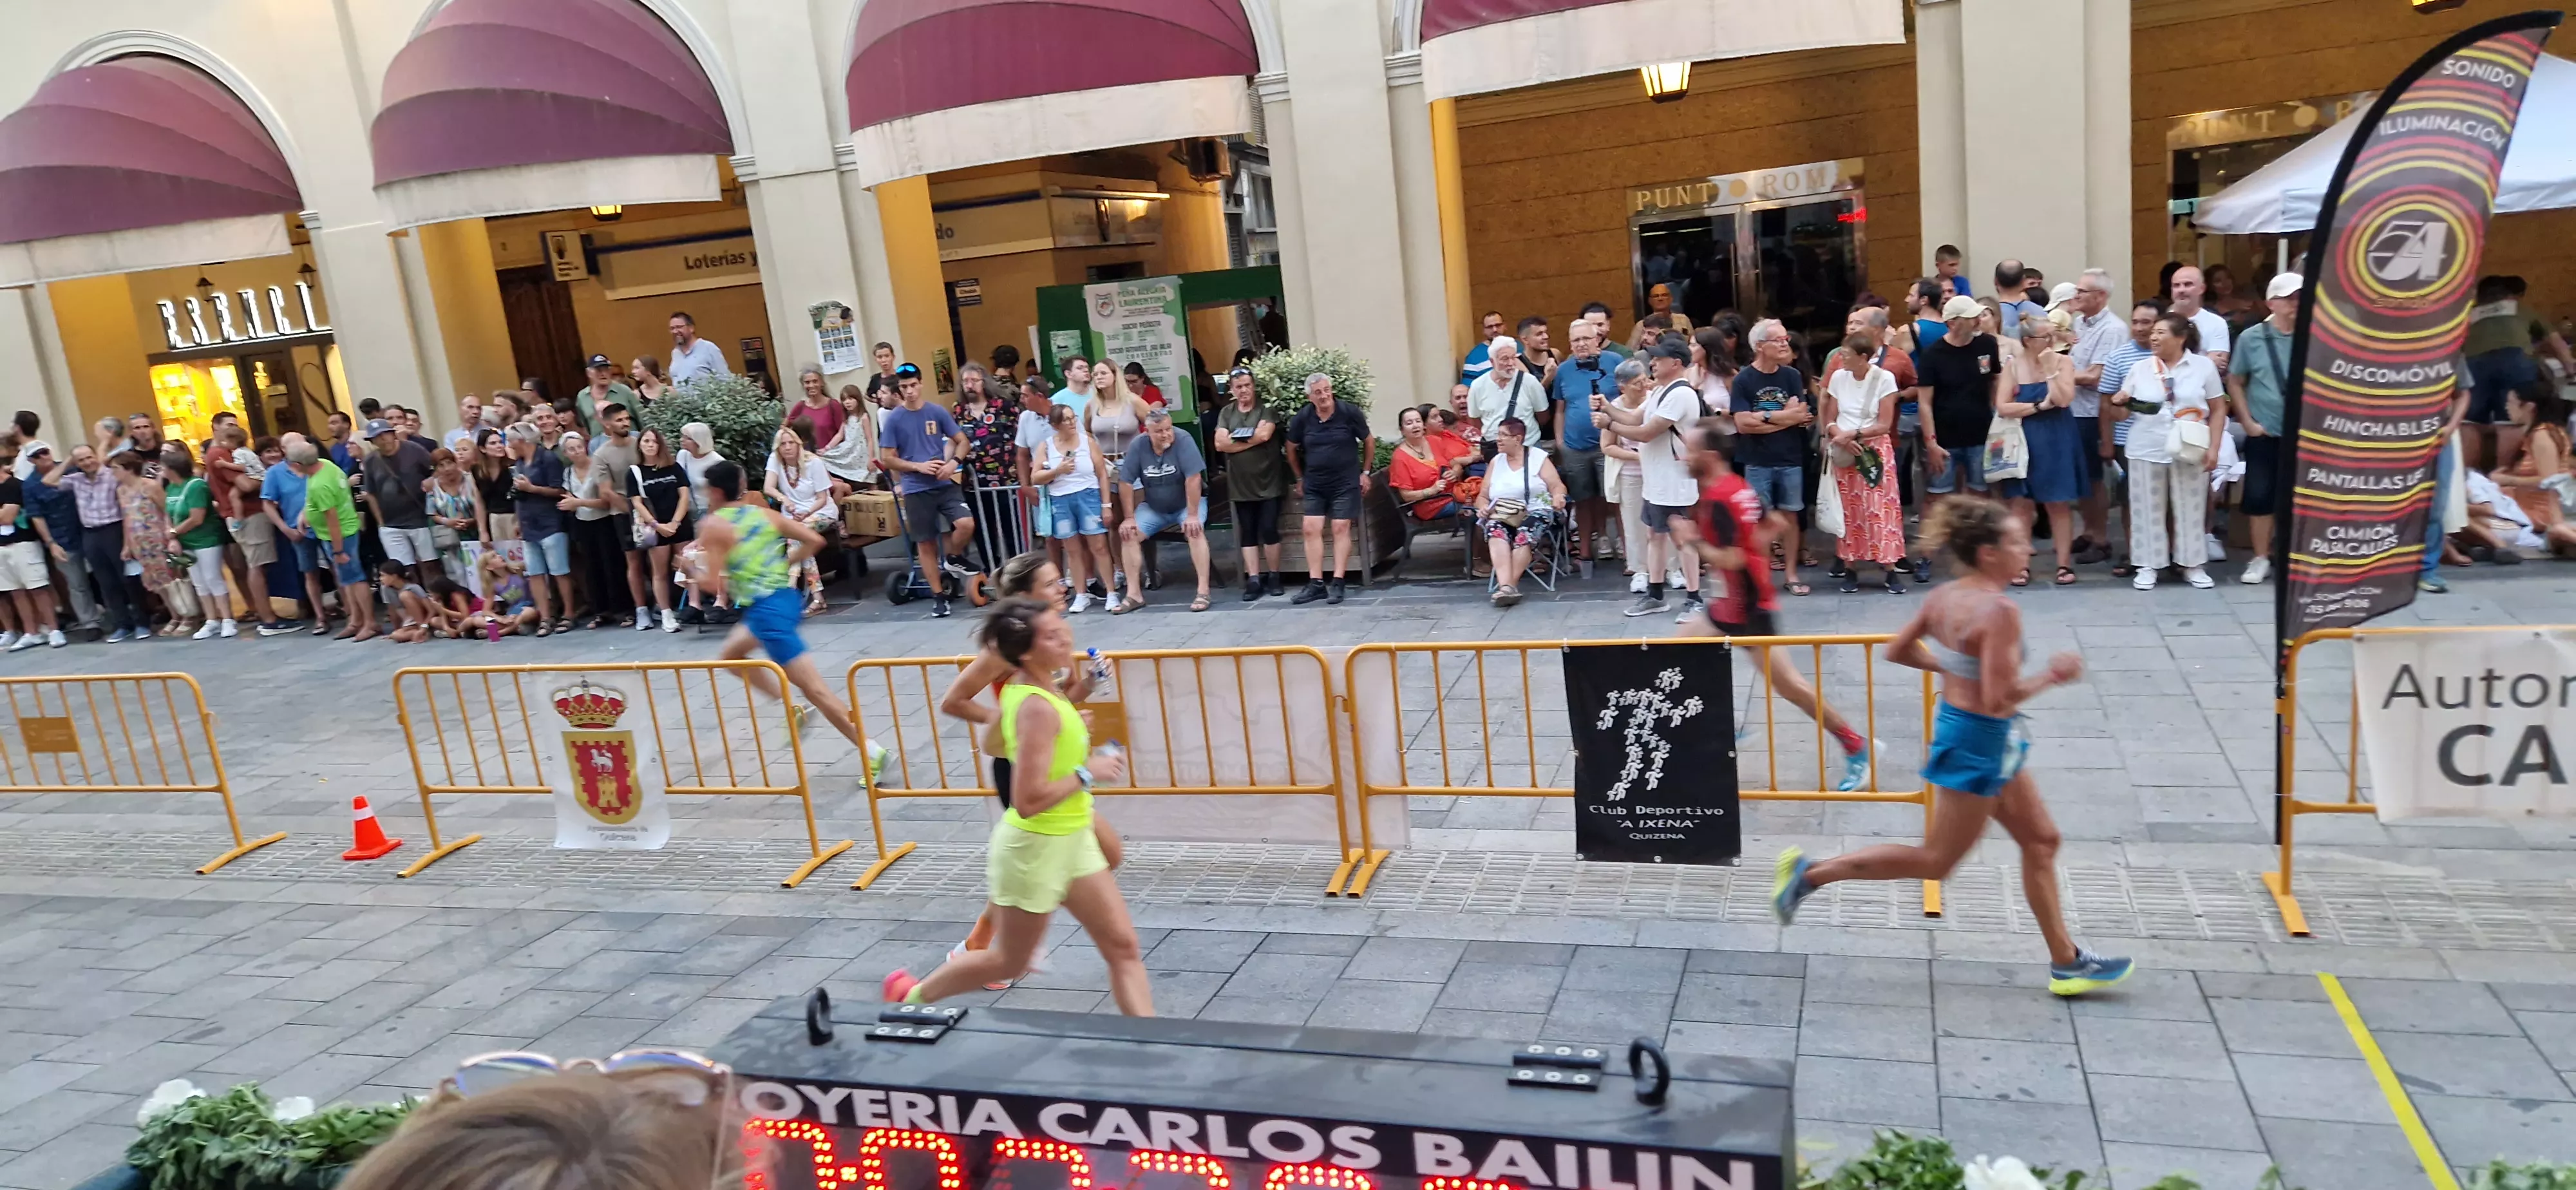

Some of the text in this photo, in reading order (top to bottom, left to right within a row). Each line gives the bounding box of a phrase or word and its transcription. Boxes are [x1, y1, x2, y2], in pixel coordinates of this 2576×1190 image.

[2441, 59, 2517, 89] SONIDO
[2379, 115, 2507, 150] ILUMINACIÓN
[1761, 167, 1827, 194] ROM
[2329, 358, 2454, 383] DISCOMÓVIL
[2323, 415, 2440, 437] HINCHABLES
[2307, 468, 2427, 489] PANTALLAS LE
[2326, 523, 2397, 540] CAMIÓN
[2438, 724, 2568, 787] CA
[1589, 805, 1725, 816] Club Deportivo
[740, 1081, 1021, 1138] OYERIA
[1038, 1101, 1382, 1169] CARLOS
[1412, 1131, 1755, 1190] BAILIN
